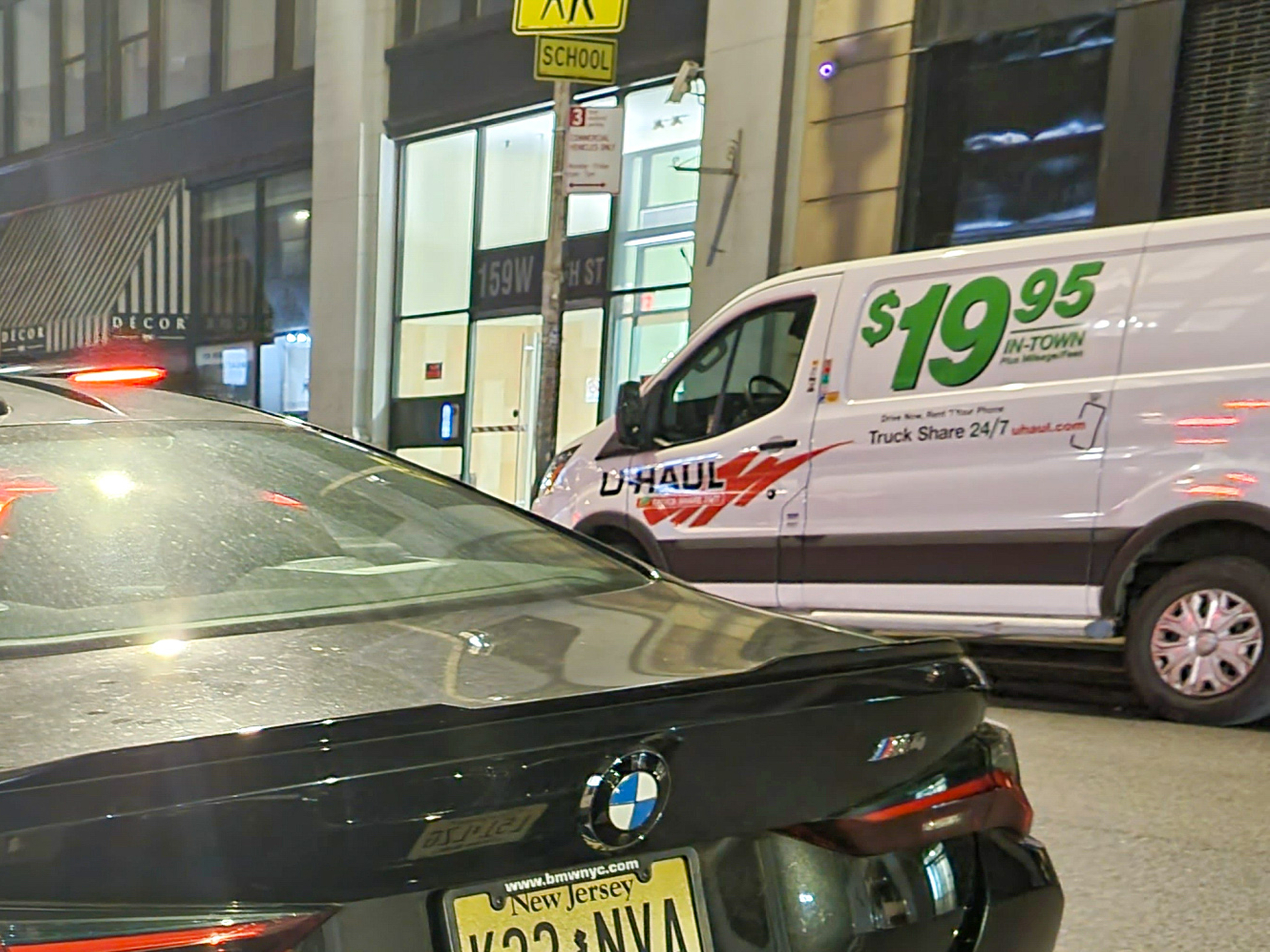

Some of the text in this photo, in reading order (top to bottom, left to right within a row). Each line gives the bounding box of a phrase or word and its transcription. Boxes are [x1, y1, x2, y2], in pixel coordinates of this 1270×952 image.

[542, 45, 609, 71] SCHOOL
[572, 108, 584, 126] 3
[584, 256, 605, 286] ST
[1003, 330, 1086, 355] IN-TOWN
[869, 418, 1086, 445] Truck Share 24/7 uhaul.com
[504, 858, 640, 893] www.bmwnyc.com
[511, 877, 635, 917] New Jersey
